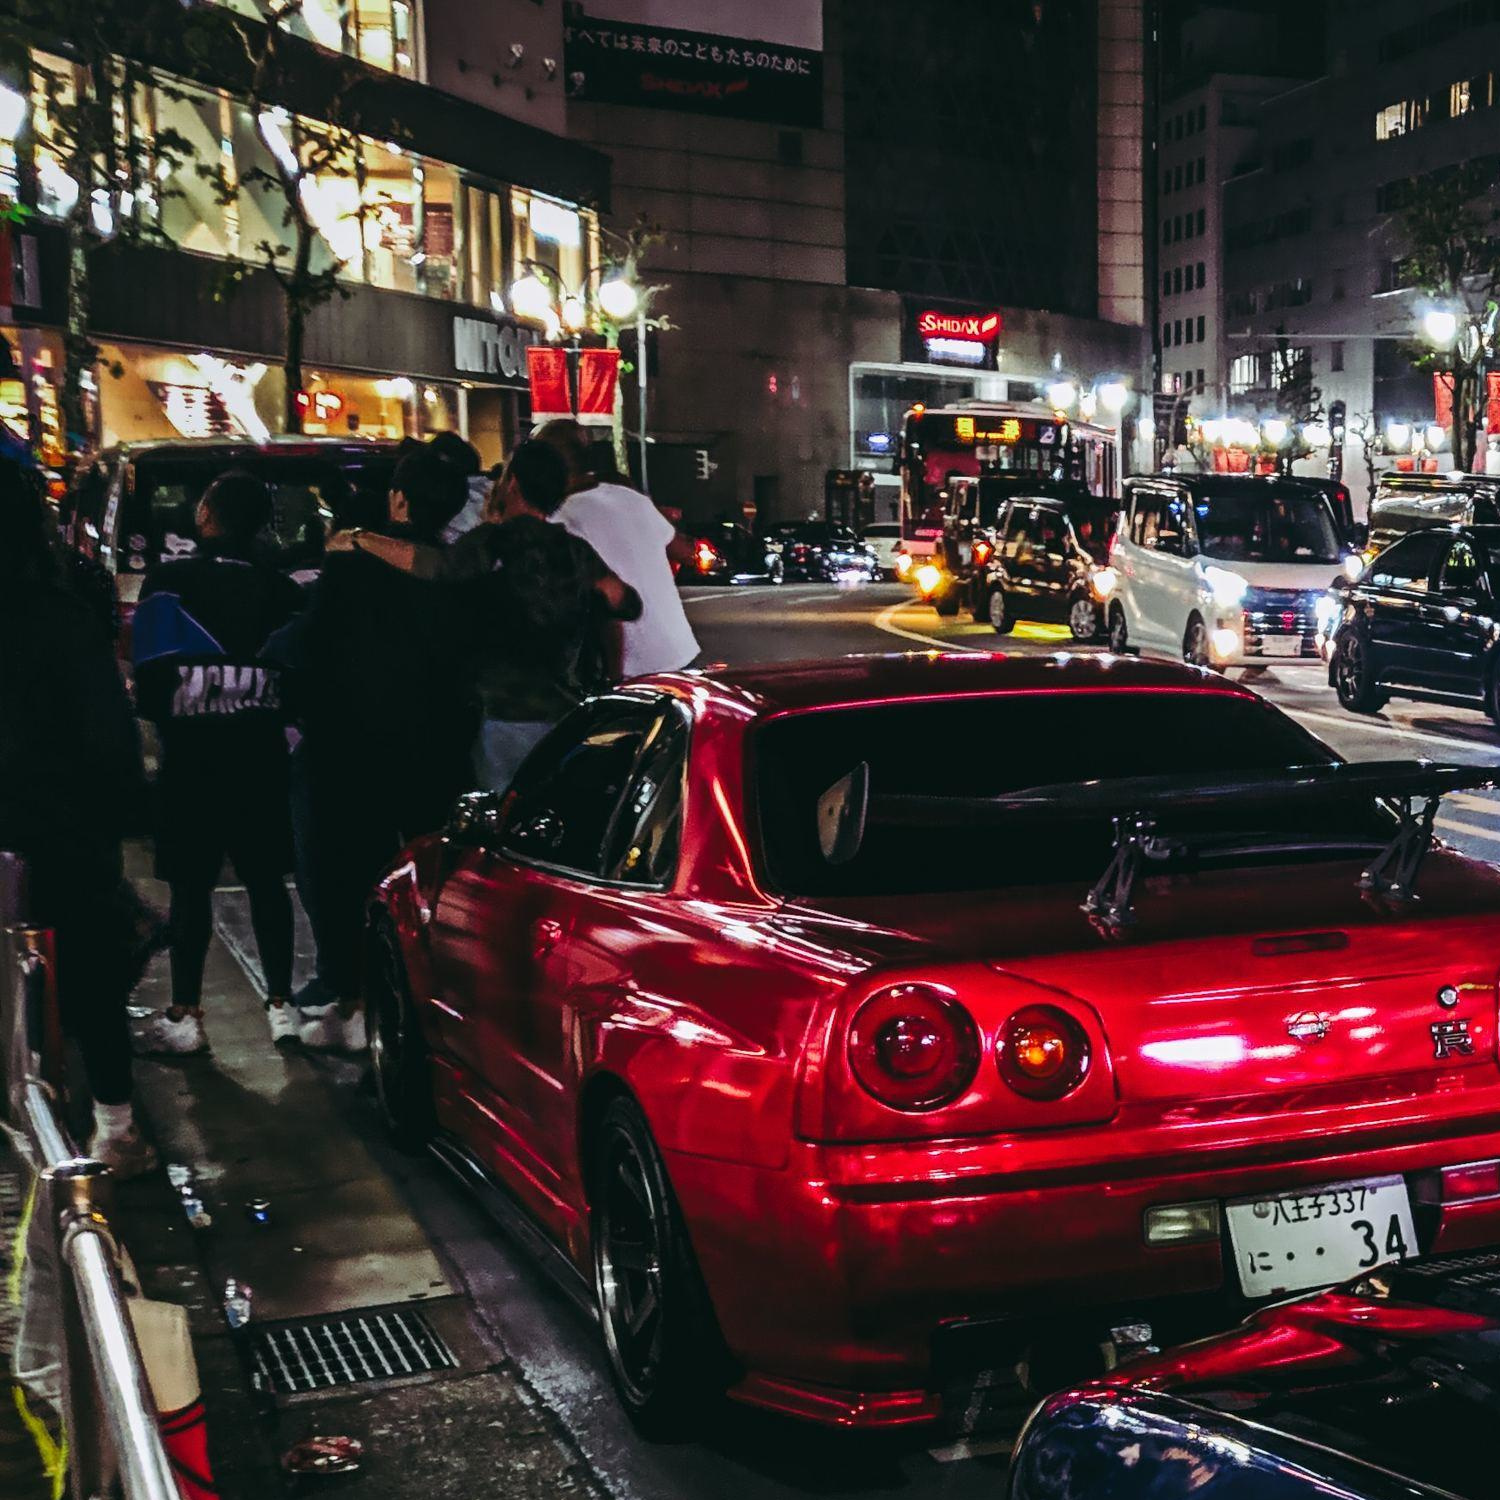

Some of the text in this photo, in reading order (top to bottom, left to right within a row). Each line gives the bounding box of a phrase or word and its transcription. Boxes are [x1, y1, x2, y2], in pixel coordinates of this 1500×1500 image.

[1272, 1186, 1367, 1226] 八王子337
[1249, 1252, 1273, 1274] に
[1351, 1214, 1408, 1267] 34
